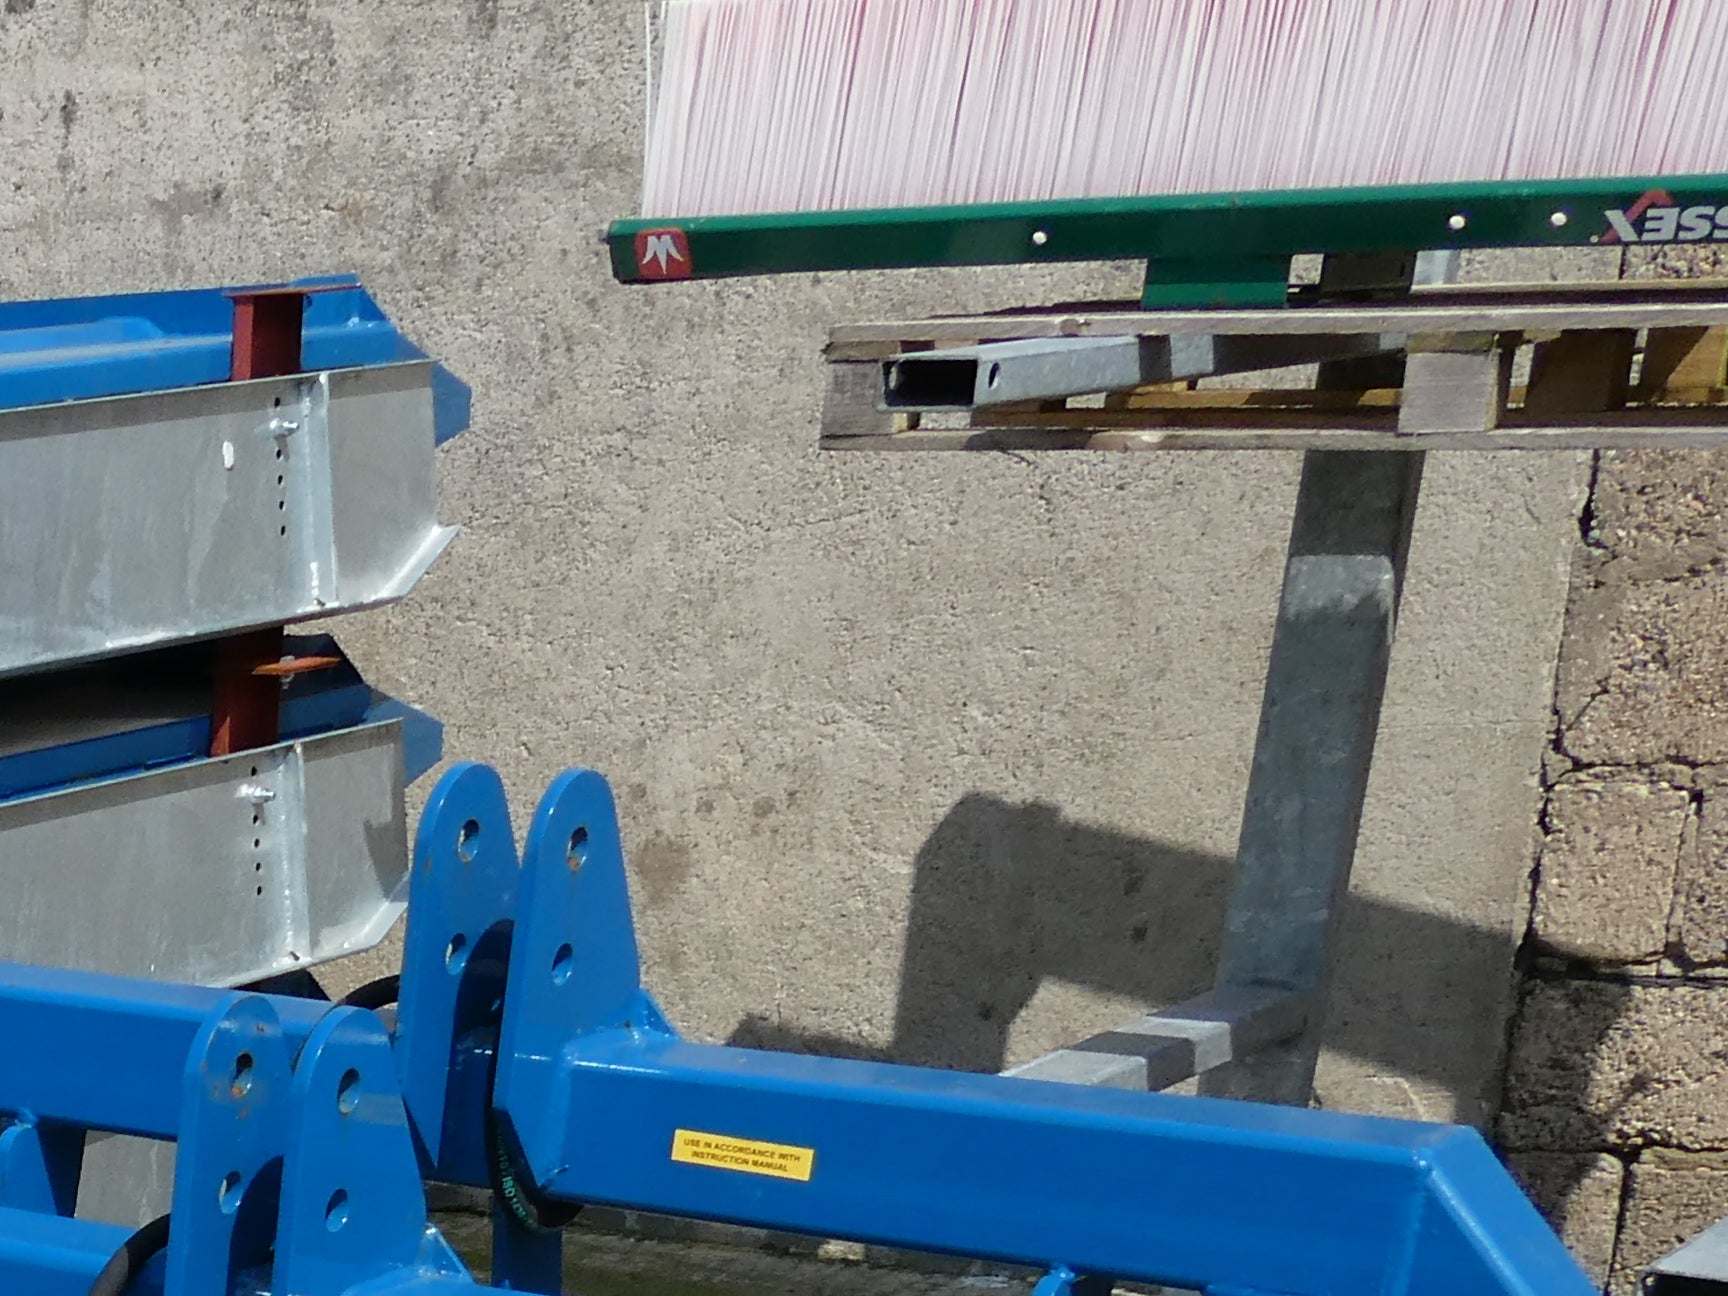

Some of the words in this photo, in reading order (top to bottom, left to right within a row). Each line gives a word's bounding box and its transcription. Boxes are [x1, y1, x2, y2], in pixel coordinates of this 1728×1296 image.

[714, 1143, 776, 1160] ACCORDANCE
[691, 1151, 749, 1166] INSTRUCTION
[751, 1159, 788, 1172] MANUAL
